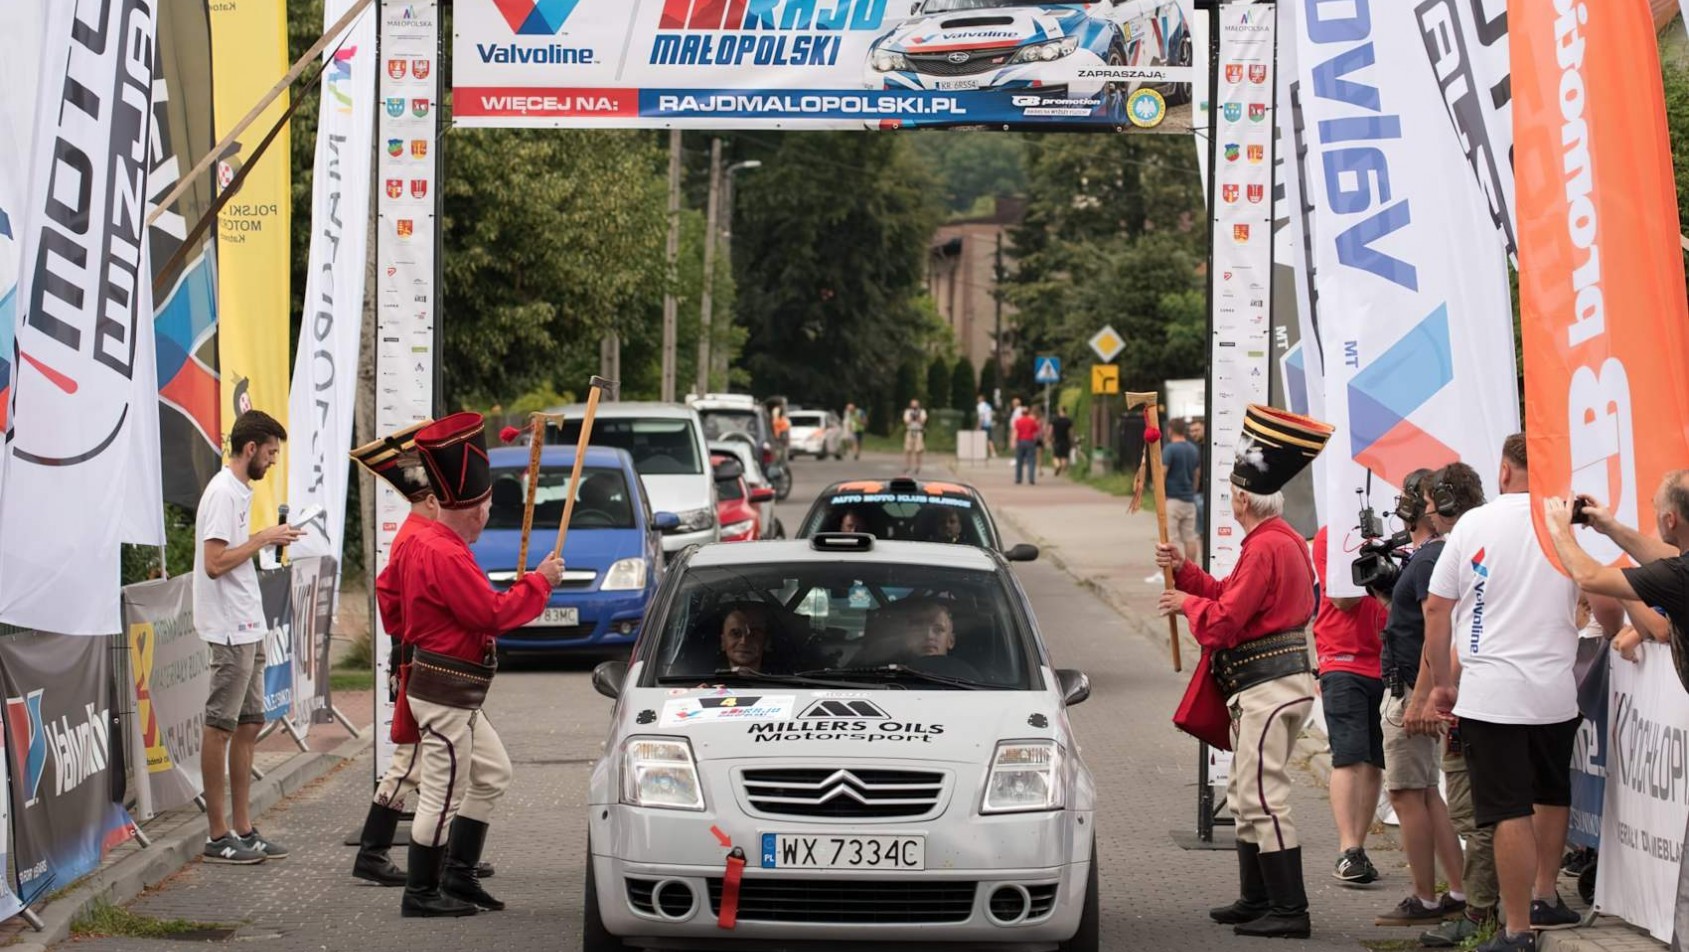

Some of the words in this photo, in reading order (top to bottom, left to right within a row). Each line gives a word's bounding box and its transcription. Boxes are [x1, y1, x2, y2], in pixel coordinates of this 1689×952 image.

[943, 31, 1018, 40] Valvoline
[477, 44, 593, 64] Valvoline
[649, 34, 842, 66] MAŁOPOLSKI
[1078, 70, 1166, 80] ZAPRASZAJĄ:
[481, 96, 571, 114] WIĘCEJ
[576, 97, 619, 112] NA:
[659, 95, 966, 114] RAJDMALOPOLSKI.PL
[831, 495, 862, 504] AUTO
[538, 609, 575, 622] 83MC
[720, 697, 737, 707] 4
[747, 721, 867, 734] MILLERS
[879, 722, 944, 734] OILS
[754, 733, 932, 743] Motorsport
[764, 854, 774, 862] PL
[783, 838, 817, 865] WX
[830, 839, 917, 866] 7334C
